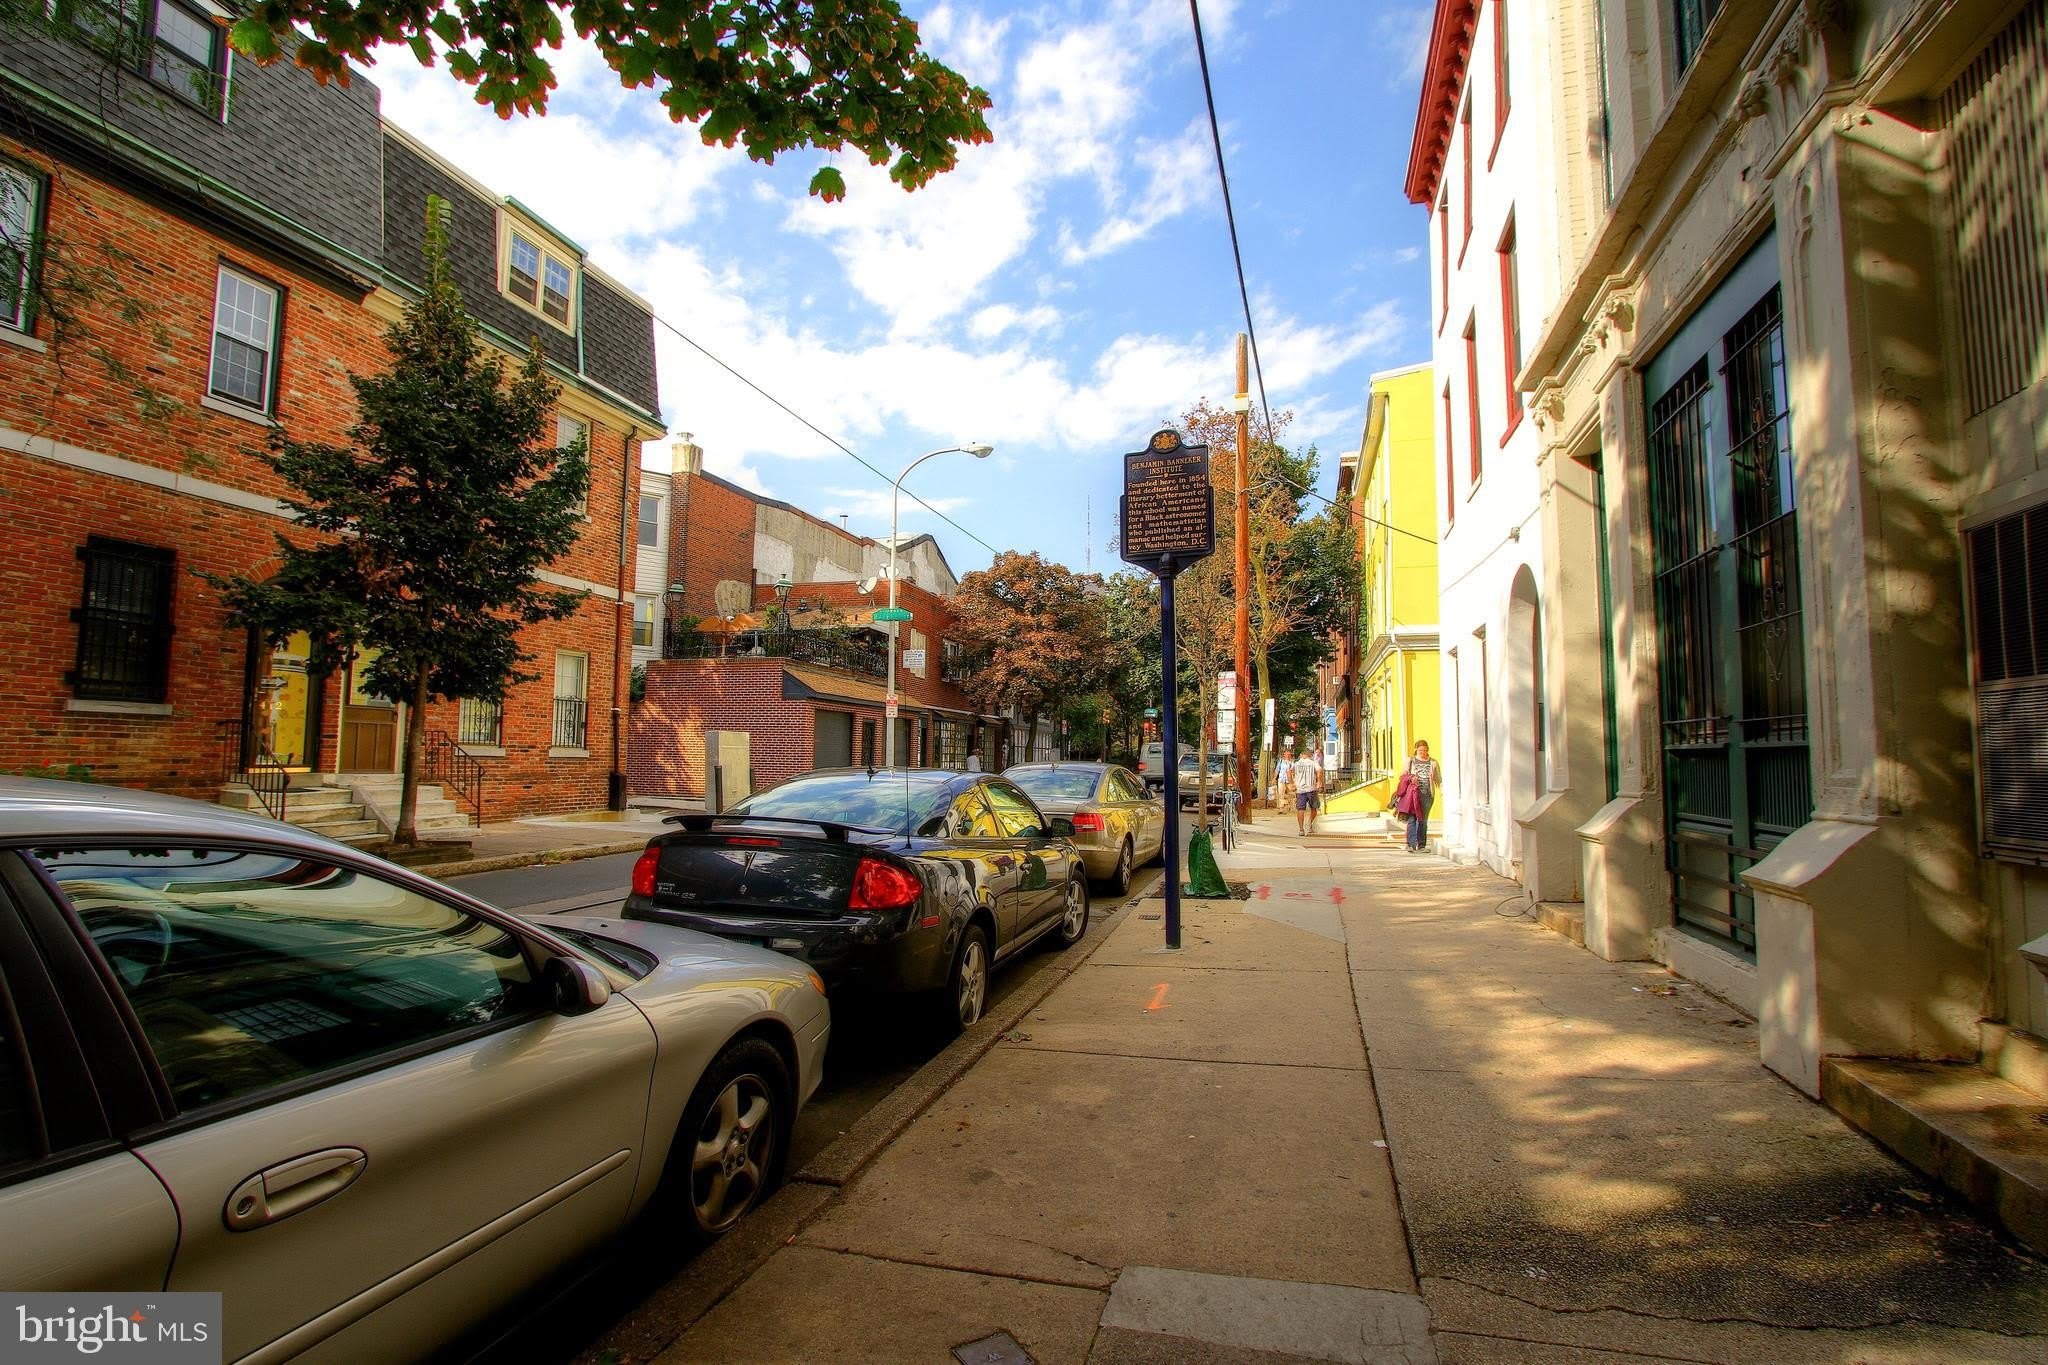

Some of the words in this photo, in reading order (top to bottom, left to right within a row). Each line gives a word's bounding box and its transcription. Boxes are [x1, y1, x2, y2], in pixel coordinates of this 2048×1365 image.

[1132, 460, 1164, 470] BENJAMIN
[1167, 456, 1201, 465] BANNEKER
[1150, 465, 1183, 474] INSTITUTE
[1128, 480, 1157, 488] Founded
[1189, 474, 1206, 482] 1854
[1143, 486, 1179, 494] dedicated
[1156, 490, 1196, 499] betterment
[1128, 501, 1157, 509] African
[1143, 506, 1165, 514] school
[1145, 513, 1164, 521] Black
[1165, 511, 1206, 519] astronomer
[1149, 518, 1206, 528] mathematician
[1145, 526, 1180, 536] published
[1165, 532, 1190, 541] helped
